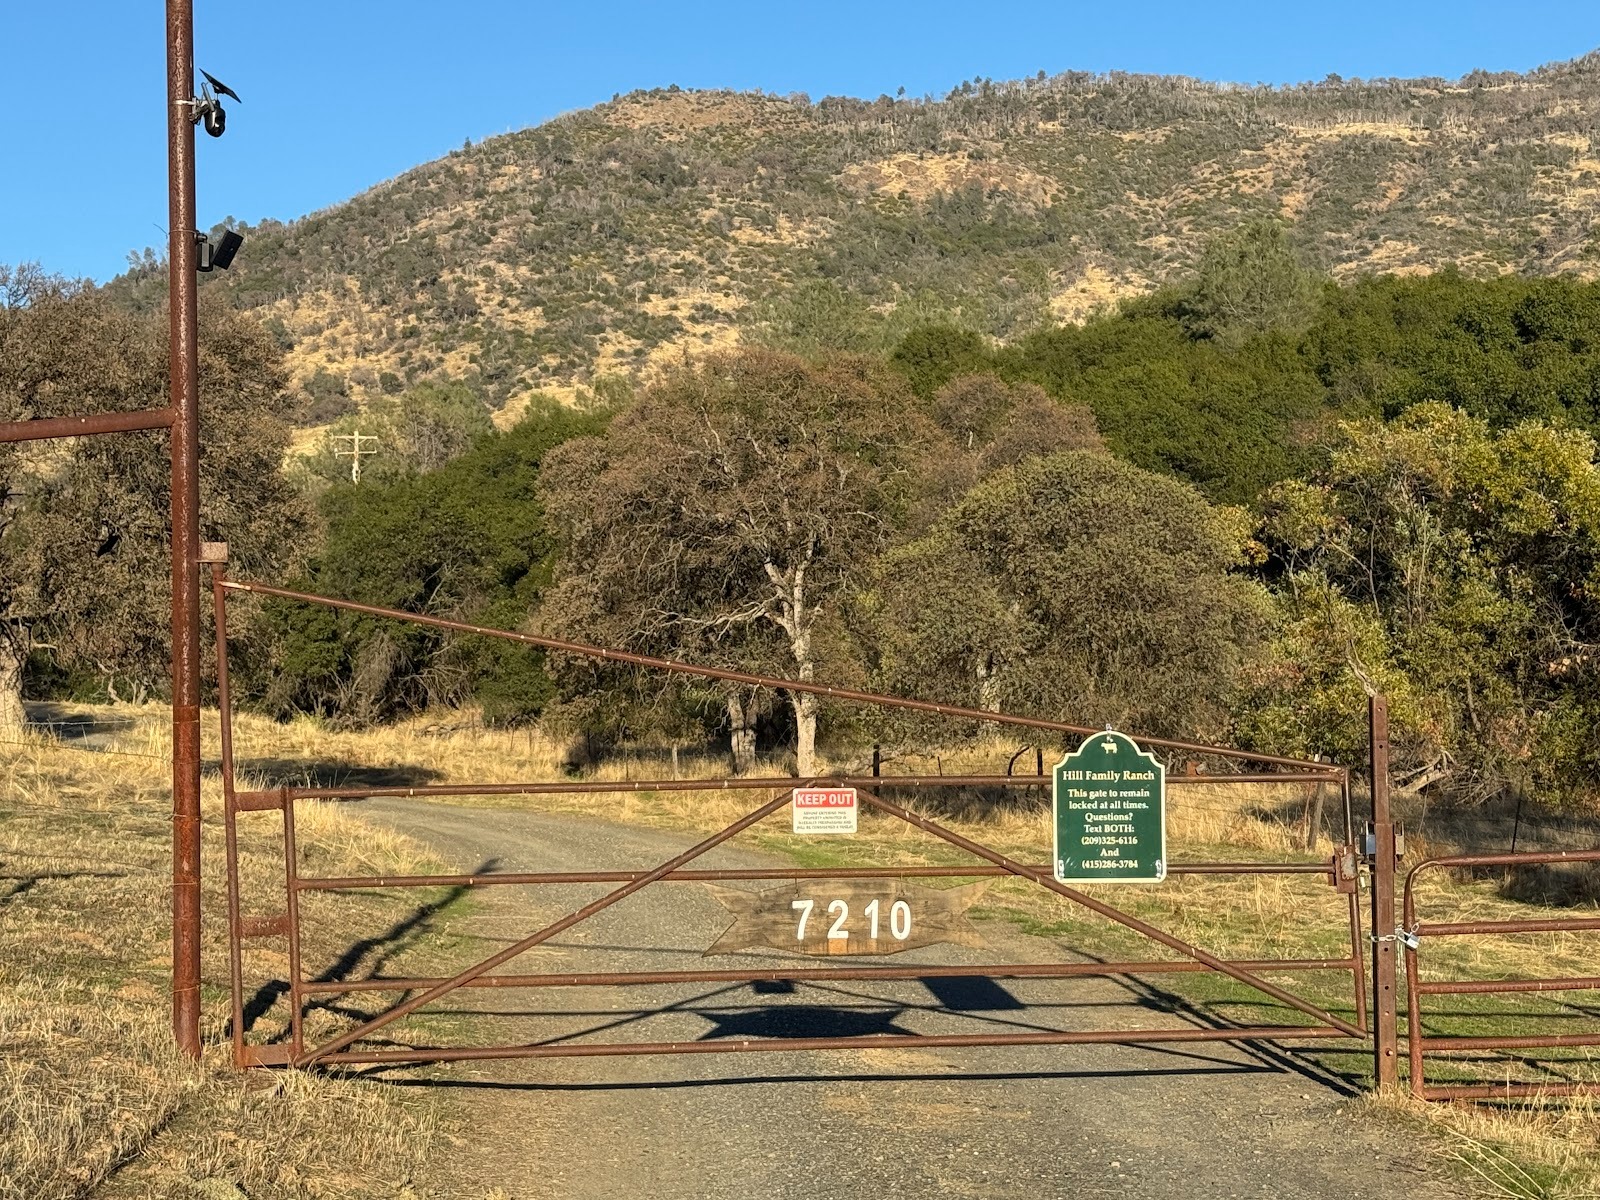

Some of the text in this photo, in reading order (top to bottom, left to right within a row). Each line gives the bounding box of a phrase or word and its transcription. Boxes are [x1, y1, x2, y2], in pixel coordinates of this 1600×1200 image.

[1063, 771, 1155, 783] Hill Family Ranch
[1067, 789, 1087, 797] This
[1089, 790, 1107, 799] gate
[1119, 789, 1150, 797] remain
[797, 793, 852, 805] KEEP OUT
[1069, 801, 1097, 809] locked
[1110, 801, 1120, 809] all
[1122, 801, 1149, 809] times.
[1085, 812, 1133, 822] Questions?
[1083, 824, 1134, 833] Text BOTH:
[1081, 836, 1138, 845] (209)325-6116
[1100, 848, 1119, 857] And
[1082, 860, 1138, 869] (415)286-3784
